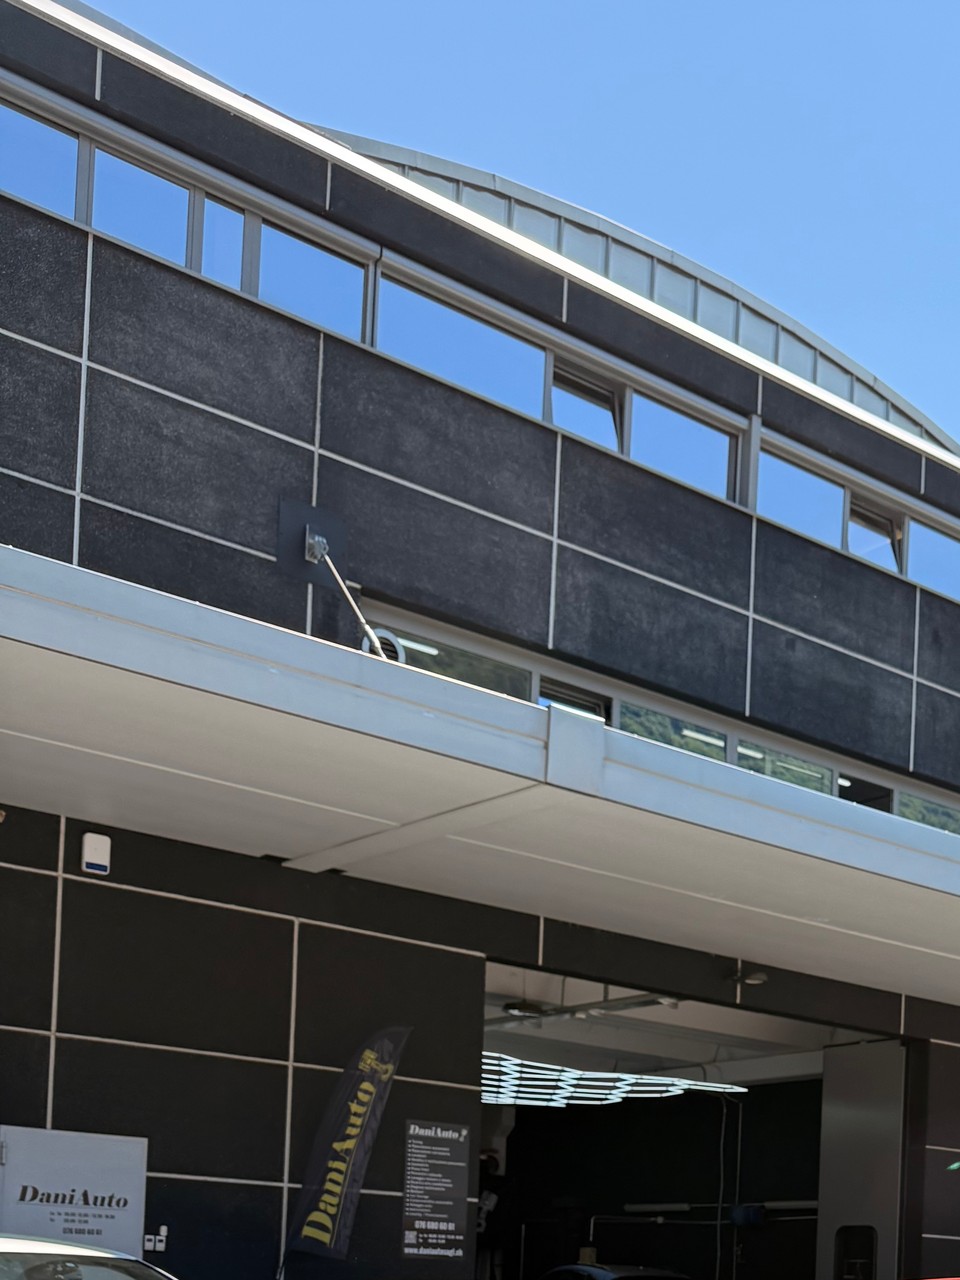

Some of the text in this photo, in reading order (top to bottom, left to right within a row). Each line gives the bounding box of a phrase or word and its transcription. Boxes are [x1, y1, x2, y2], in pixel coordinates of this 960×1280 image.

[410, 1124, 459, 1139] DaniAuto
[302, 1081, 376, 1246] DaniAuto
[18, 1185, 128, 1208] DaniAuto
